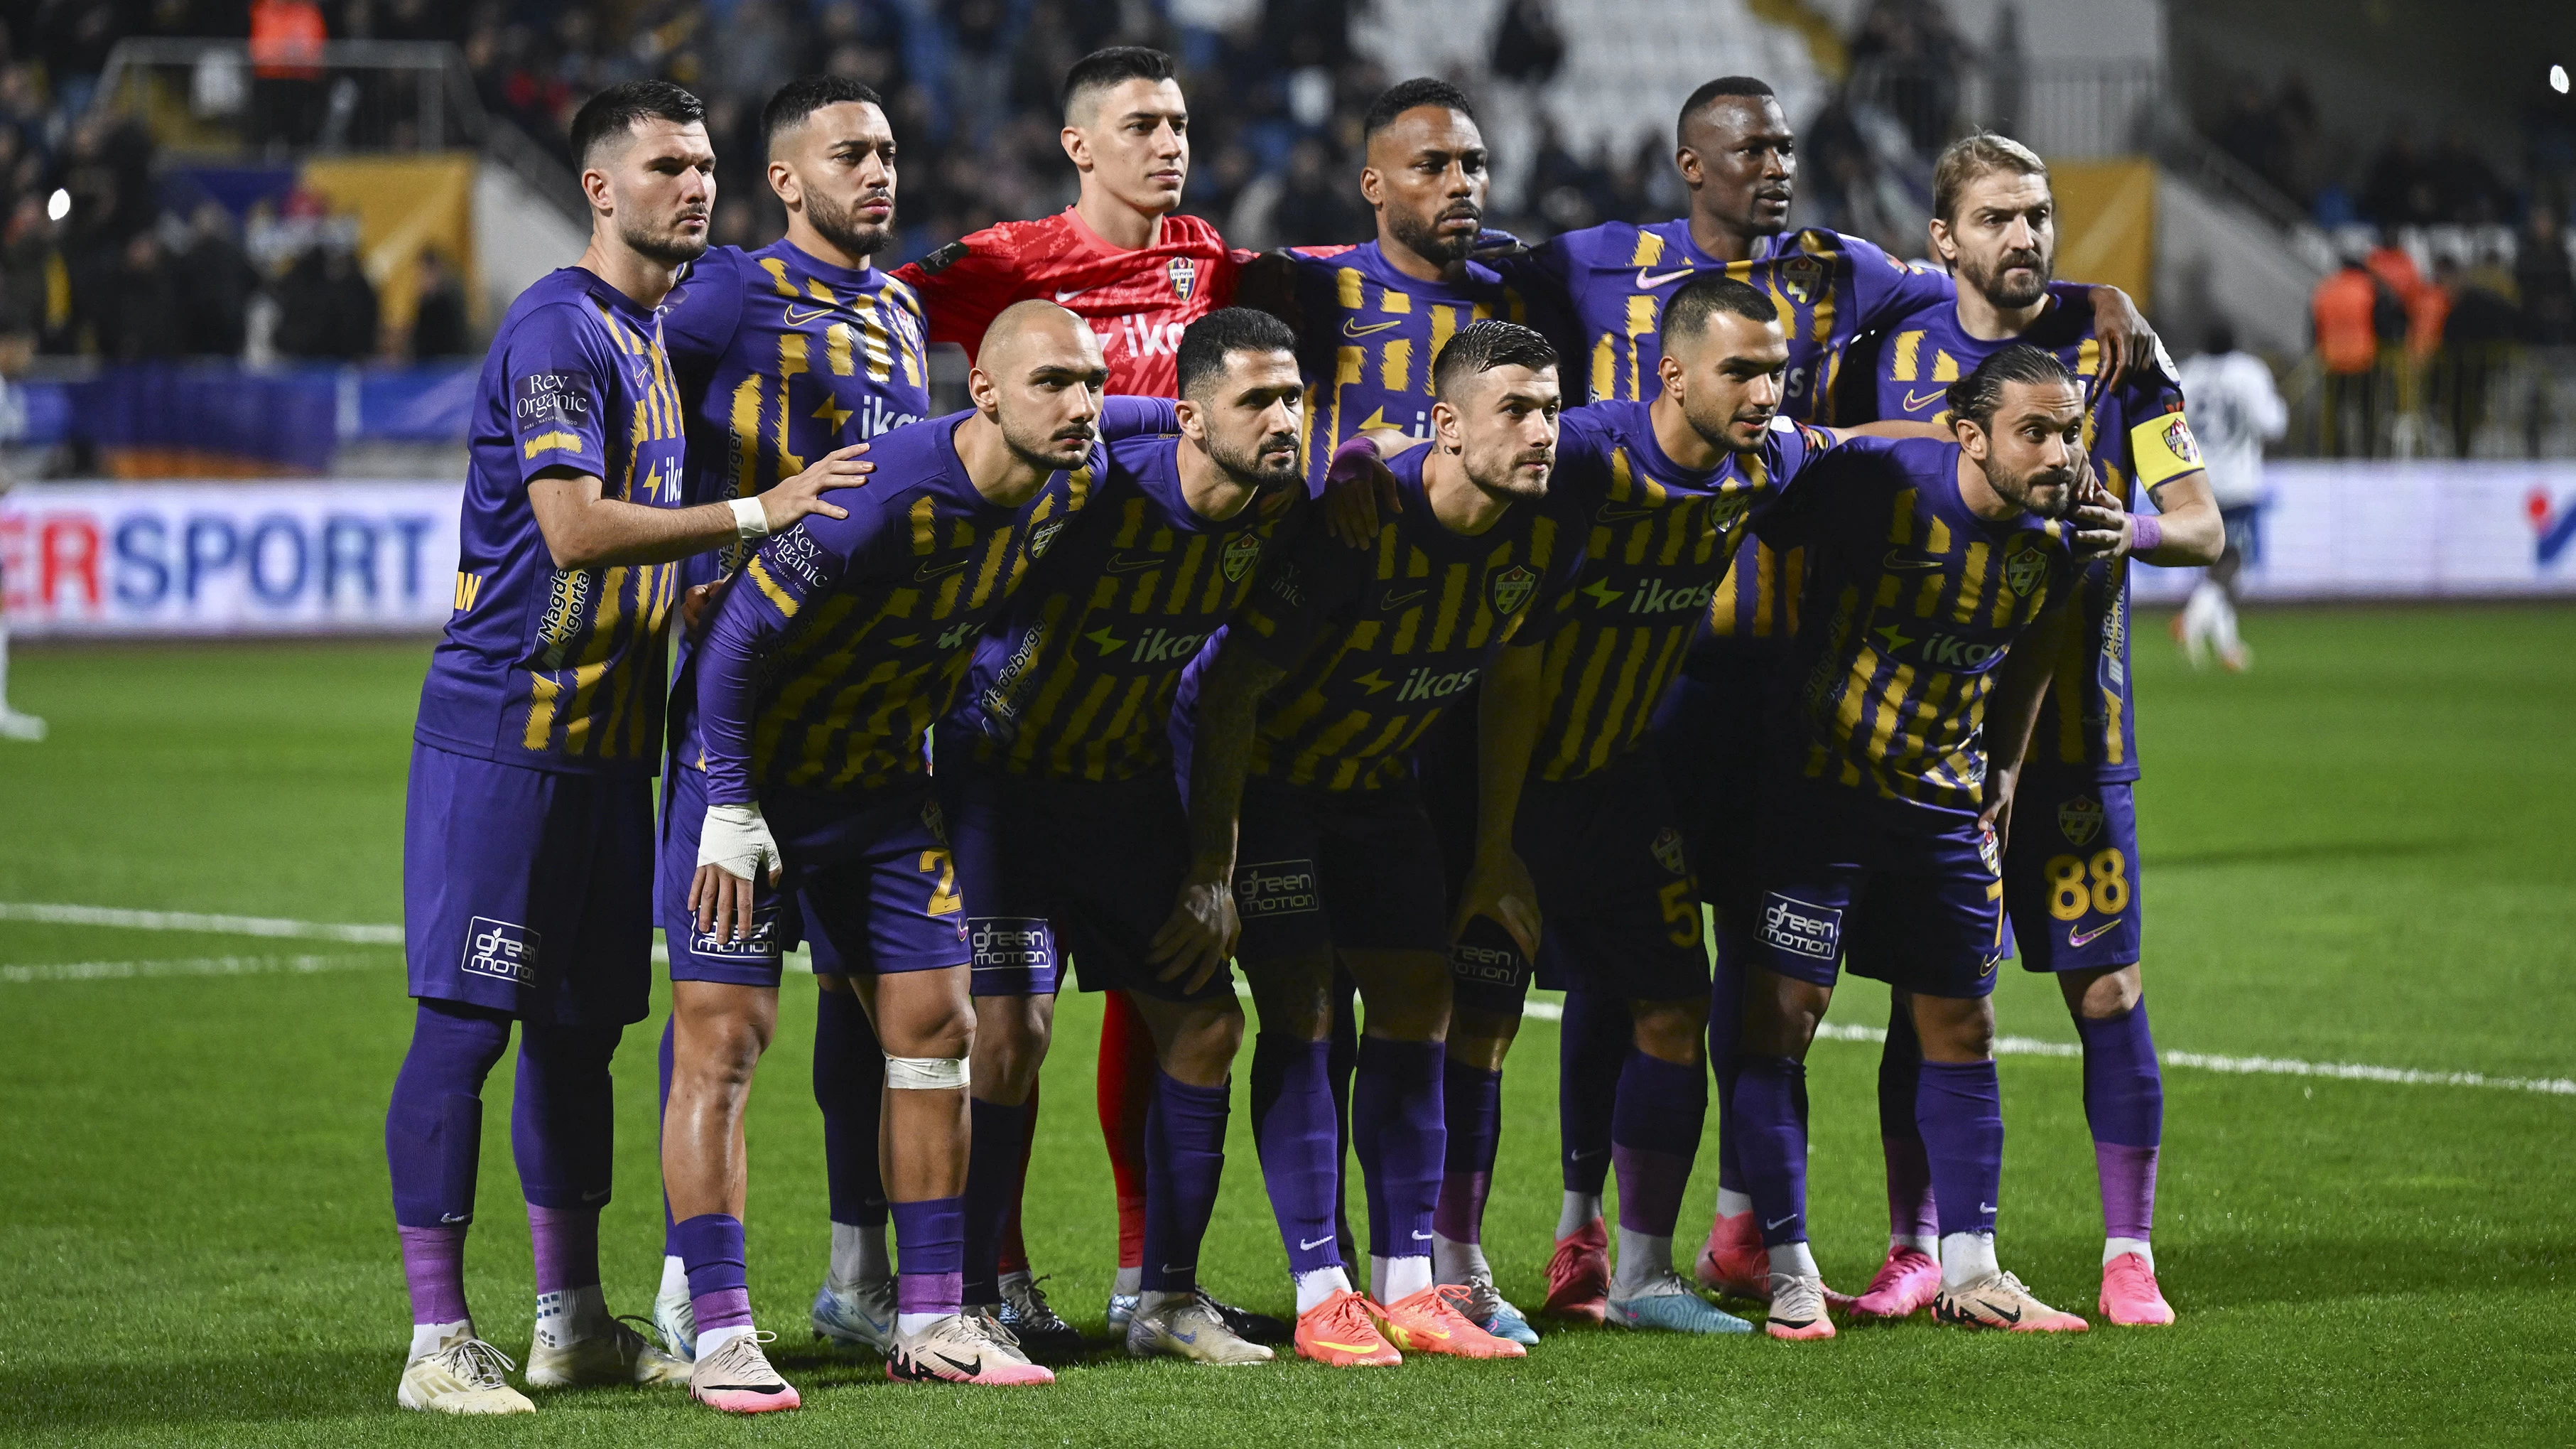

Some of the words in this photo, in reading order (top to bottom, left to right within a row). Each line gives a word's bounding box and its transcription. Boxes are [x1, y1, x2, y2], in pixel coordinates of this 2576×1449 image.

[529, 374, 568, 394] Rey
[516, 391, 588, 419] Organic
[787, 522, 823, 561] Rey
[558, 570, 590, 647] Sigorta
[1628, 578, 1714, 613] ikas
[2114, 585, 2126, 659] Sigorta
[1131, 627, 1214, 662] ika
[1921, 632, 2001, 667] ika
[1396, 667, 1480, 701] ikas
[919, 847, 965, 916] 2
[1240, 873, 1312, 900] green
[2044, 847, 2130, 921] 88
[1658, 876, 1701, 949] 5
[1766, 906, 1834, 939] green
[476, 933, 536, 963] green
[973, 930, 1044, 953] green
